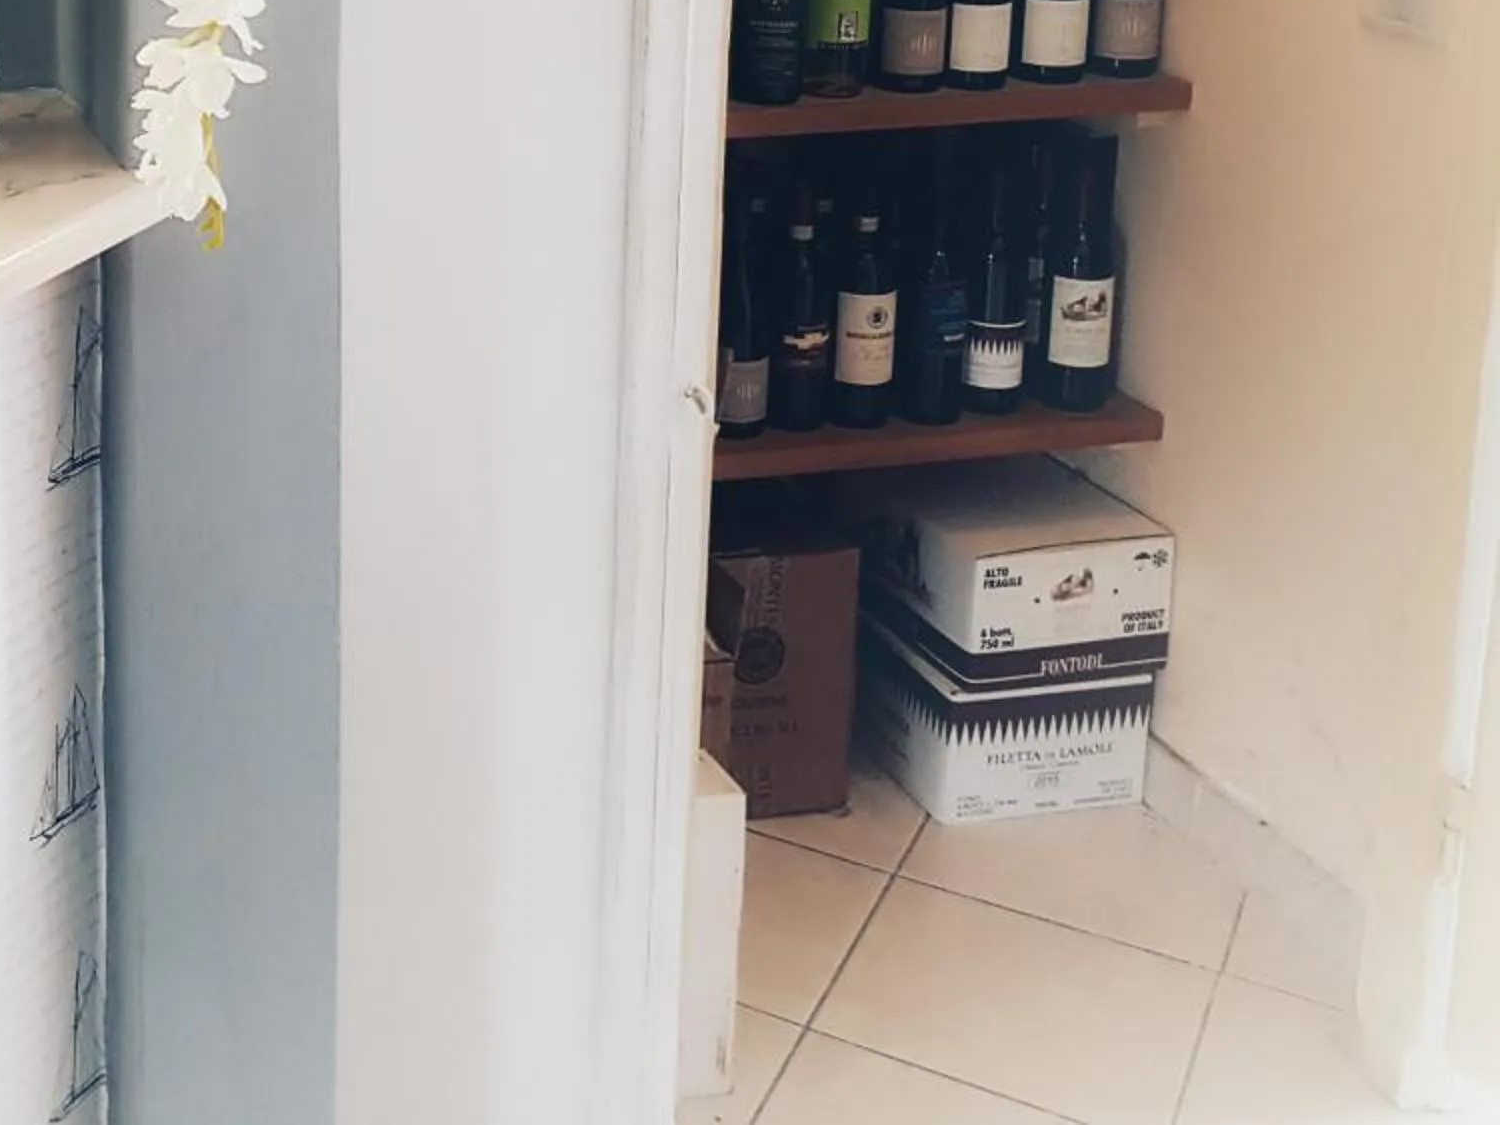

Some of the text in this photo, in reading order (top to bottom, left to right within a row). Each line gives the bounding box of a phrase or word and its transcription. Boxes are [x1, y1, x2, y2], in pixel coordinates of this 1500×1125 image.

[985, 566, 1009, 578] ALTO
[983, 575, 1023, 590] FRAGILE
[1122, 608, 1165, 622] PRODUCT
[1137, 619, 1164, 632] ITALY
[1041, 652, 1103, 676] FONTODI
